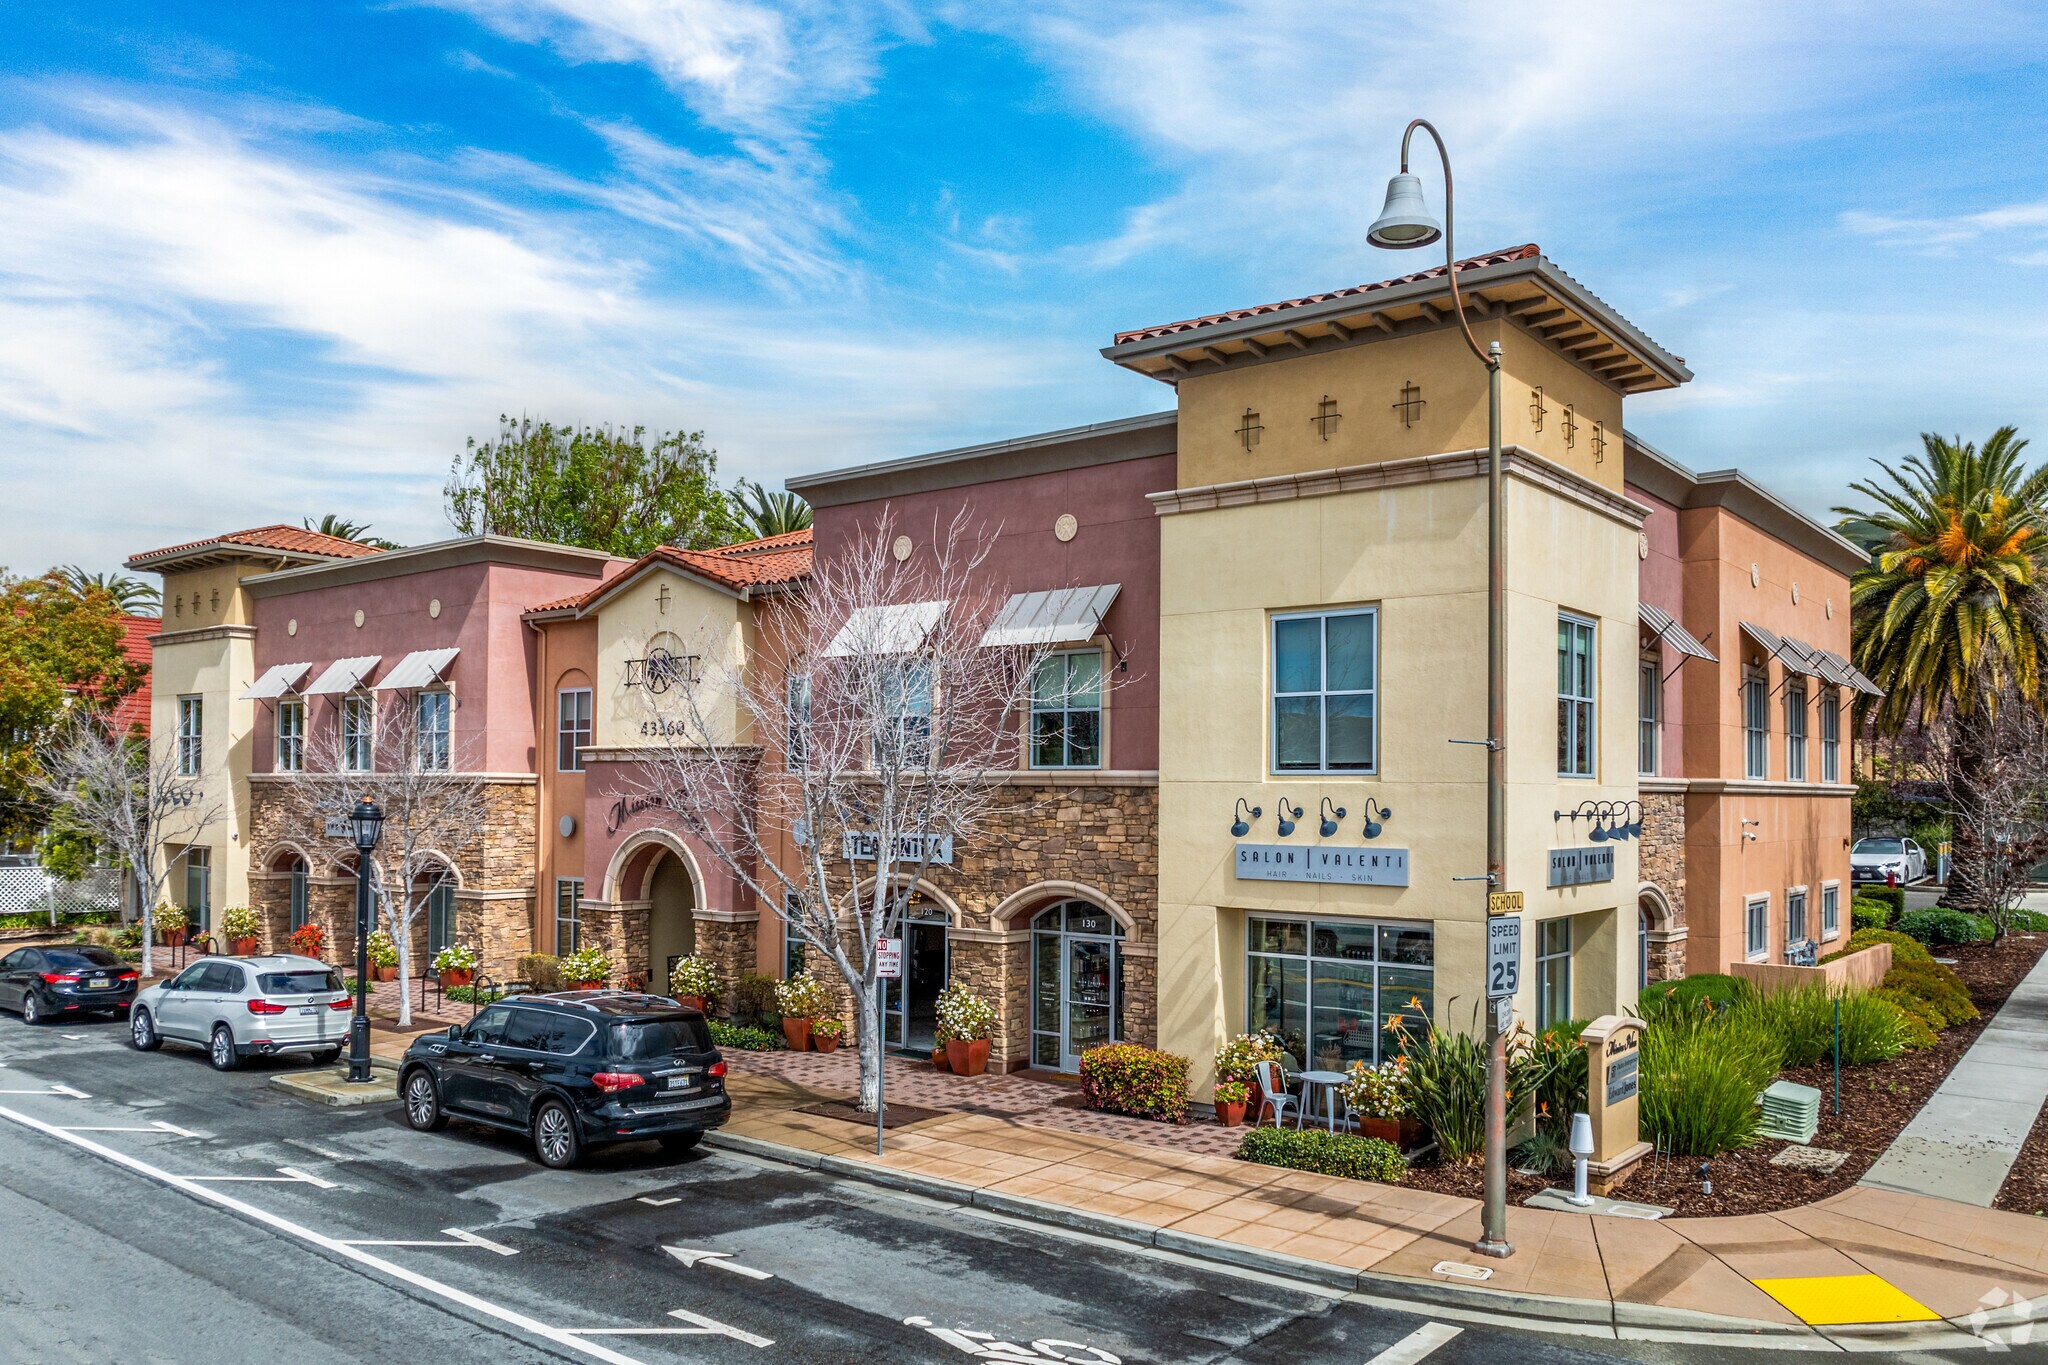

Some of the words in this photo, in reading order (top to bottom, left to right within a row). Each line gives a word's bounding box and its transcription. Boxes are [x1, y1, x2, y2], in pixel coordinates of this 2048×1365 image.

[1241, 850, 1294, 864] SALON
[1322, 853, 1402, 868] VALENTI
[1266, 870, 1288, 878] HAIR
[1306, 872, 1332, 880] NAILS
[1351, 874, 1373, 882] SKIN
[1490, 894, 1522, 911] SCHOOL
[921, 907, 933, 916] 120
[1082, 919, 1096, 928] 130
[1491, 924, 1519, 938] SPEED
[877, 940, 887, 950] NO
[1493, 942, 1517, 956] LIMIT
[878, 951, 900, 960] STOPPING
[1491, 960, 1517, 991] 25
